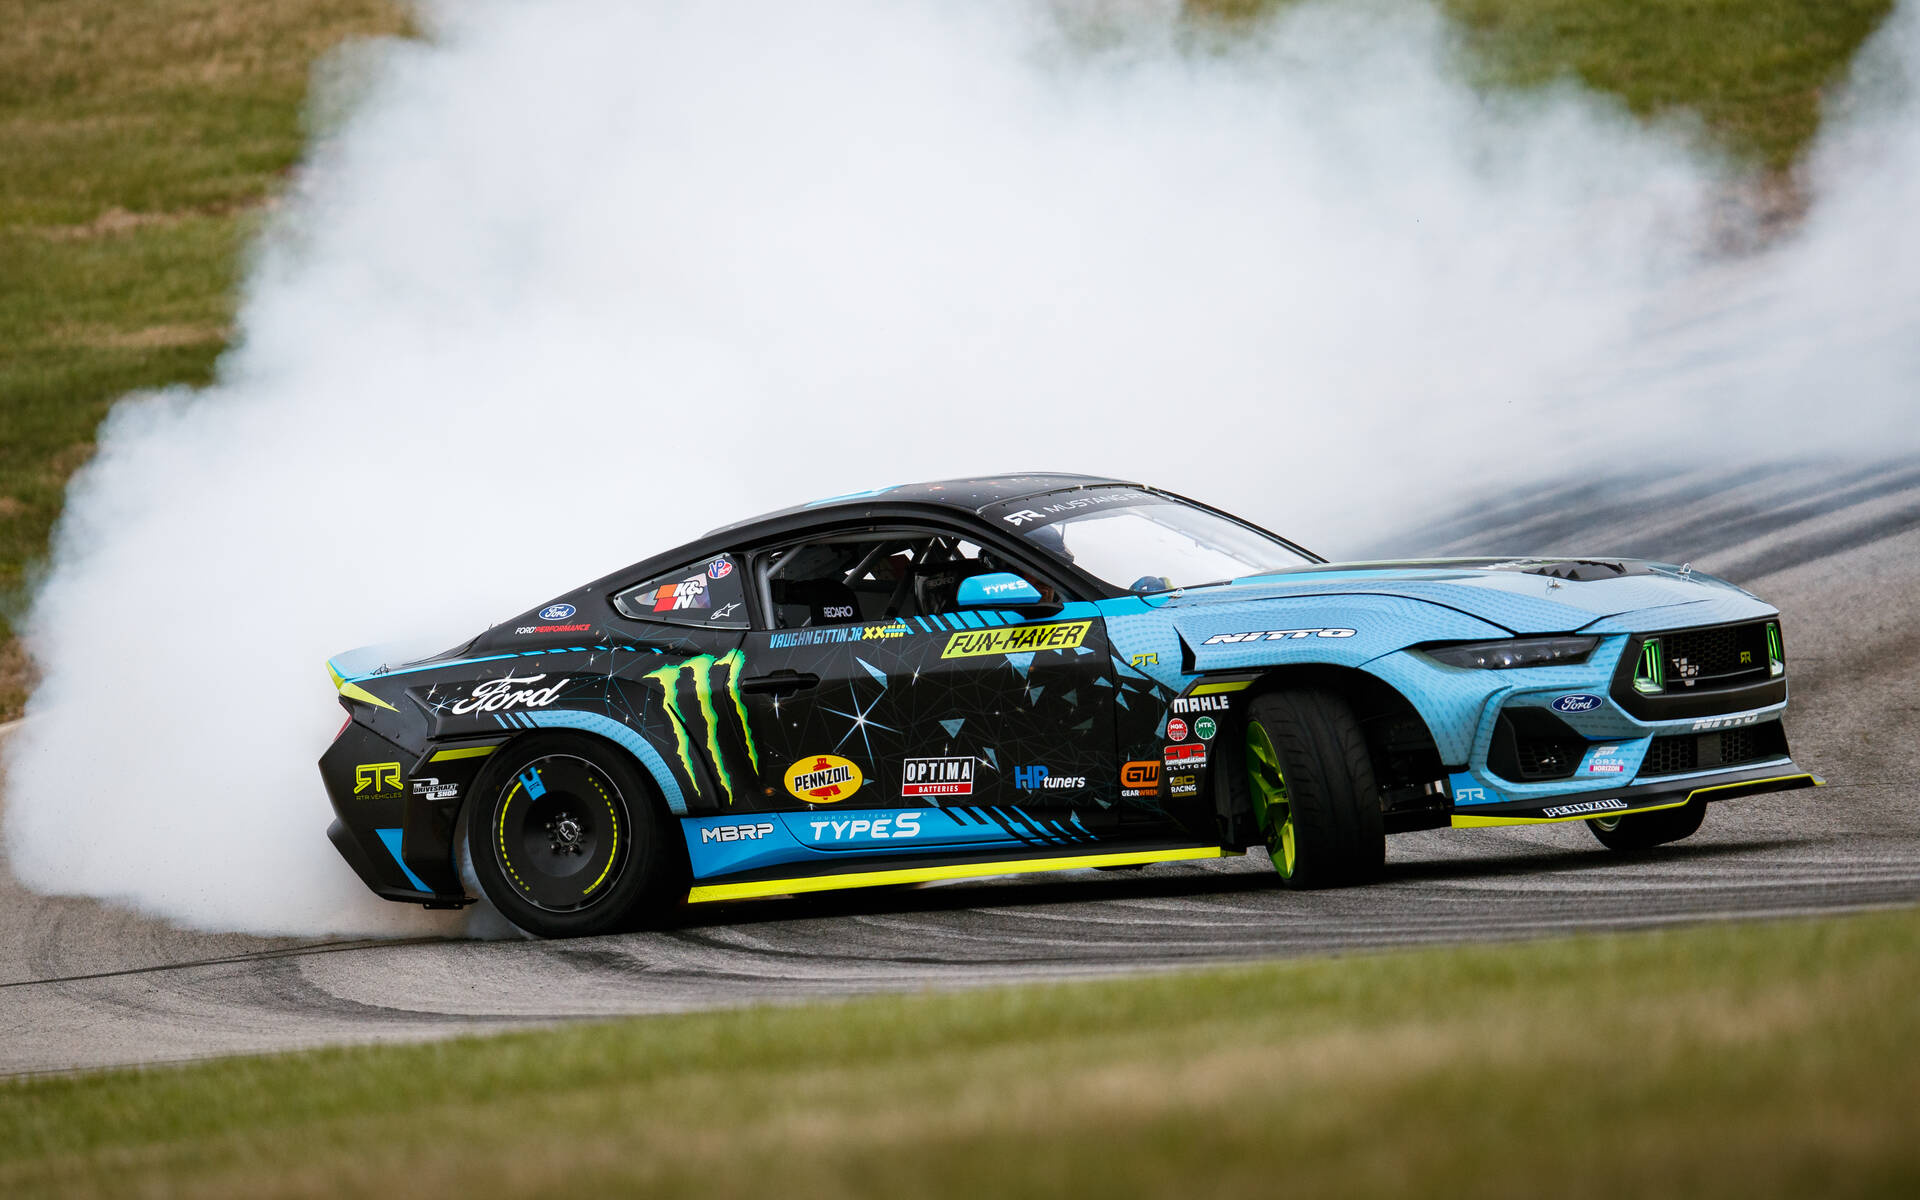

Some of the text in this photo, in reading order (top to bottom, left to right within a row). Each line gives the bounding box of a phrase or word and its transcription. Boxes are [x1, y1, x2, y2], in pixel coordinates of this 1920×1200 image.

[544, 605, 569, 618] Ford
[823, 605, 853, 618] RECARO
[769, 631, 814, 649] VAUGHN
[814, 628, 849, 645] GITTIN
[947, 624, 1086, 655] FUN-HAVER
[1201, 627, 1357, 645] NITTO
[451, 673, 570, 715] Ford
[1560, 695, 1594, 711] Ford
[1173, 695, 1229, 713] MAHLE
[907, 761, 970, 782] OPTIMA
[1166, 763, 1207, 771] CLUTCH
[794, 765, 852, 793] PENNZOIL
[370, 792, 402, 800] VEHICLES
[918, 784, 959, 793] BATTERIES
[1171, 784, 1197, 794] RACING
[1543, 799, 1628, 818] PENNZOIL
[701, 823, 774, 844] MBRP
